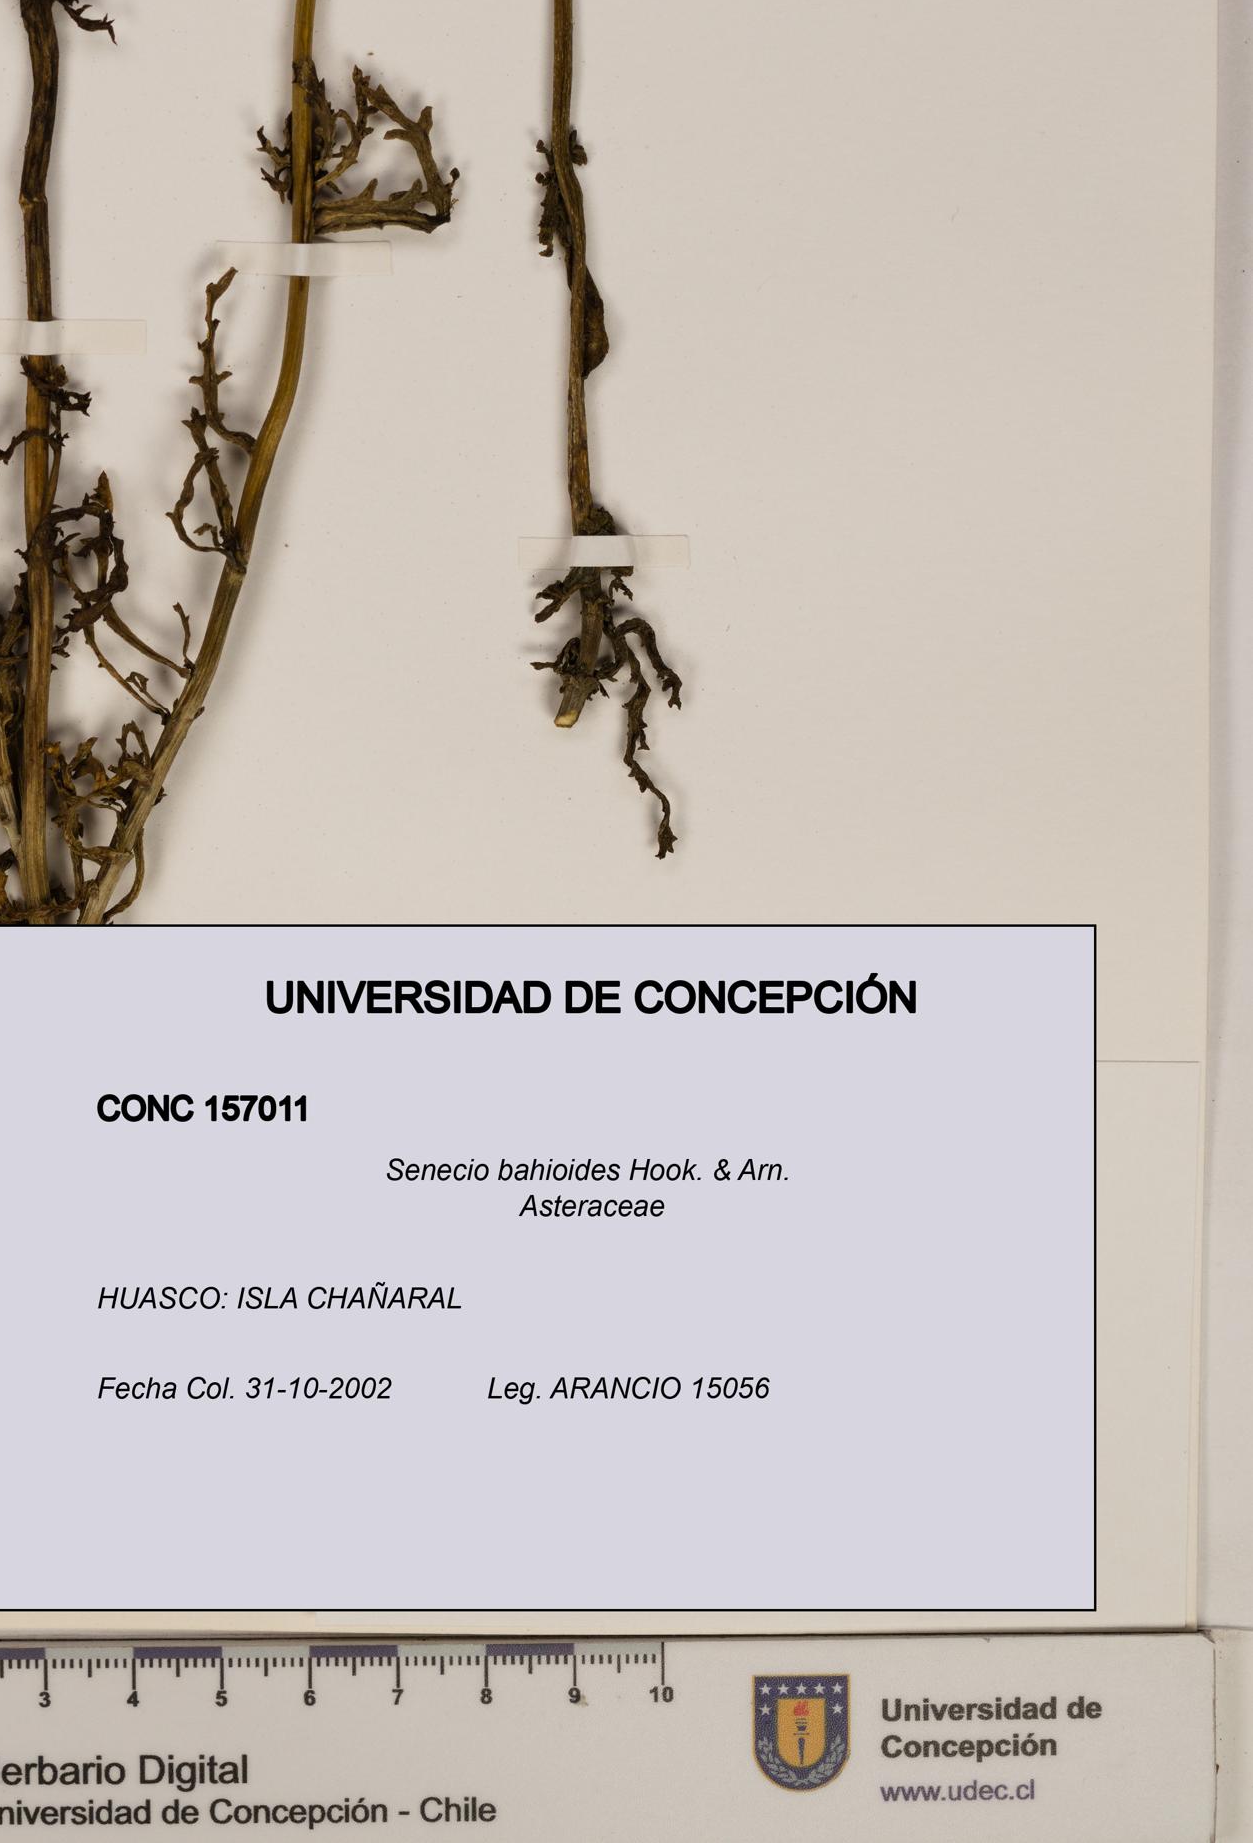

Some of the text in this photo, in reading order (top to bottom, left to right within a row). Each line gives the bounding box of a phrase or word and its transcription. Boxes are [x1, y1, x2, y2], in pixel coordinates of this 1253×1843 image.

[39, 1692, 51, 1707] 3
[127, 1691, 139, 1707] 4
[216, 1690, 227, 1706] 5
[304, 1688, 315, 1706] 6
[392, 1689, 403, 1705] 7
[481, 1688, 492, 1704] 8
[569, 1688, 581, 1703] 9
[650, 1687, 673, 1702] 10
[882, 1696, 1102, 1721] Universidad de
[881, 1733, 1056, 1762] Concepción
[140, 1754, 247, 1792] Digital
[880, 1779, 1034, 1801] www.udec.cl
[162, 1799, 199, 1824] de
[210, 1798, 387, 1829] Concepción
[420, 1797, 496, 1822] Chile
